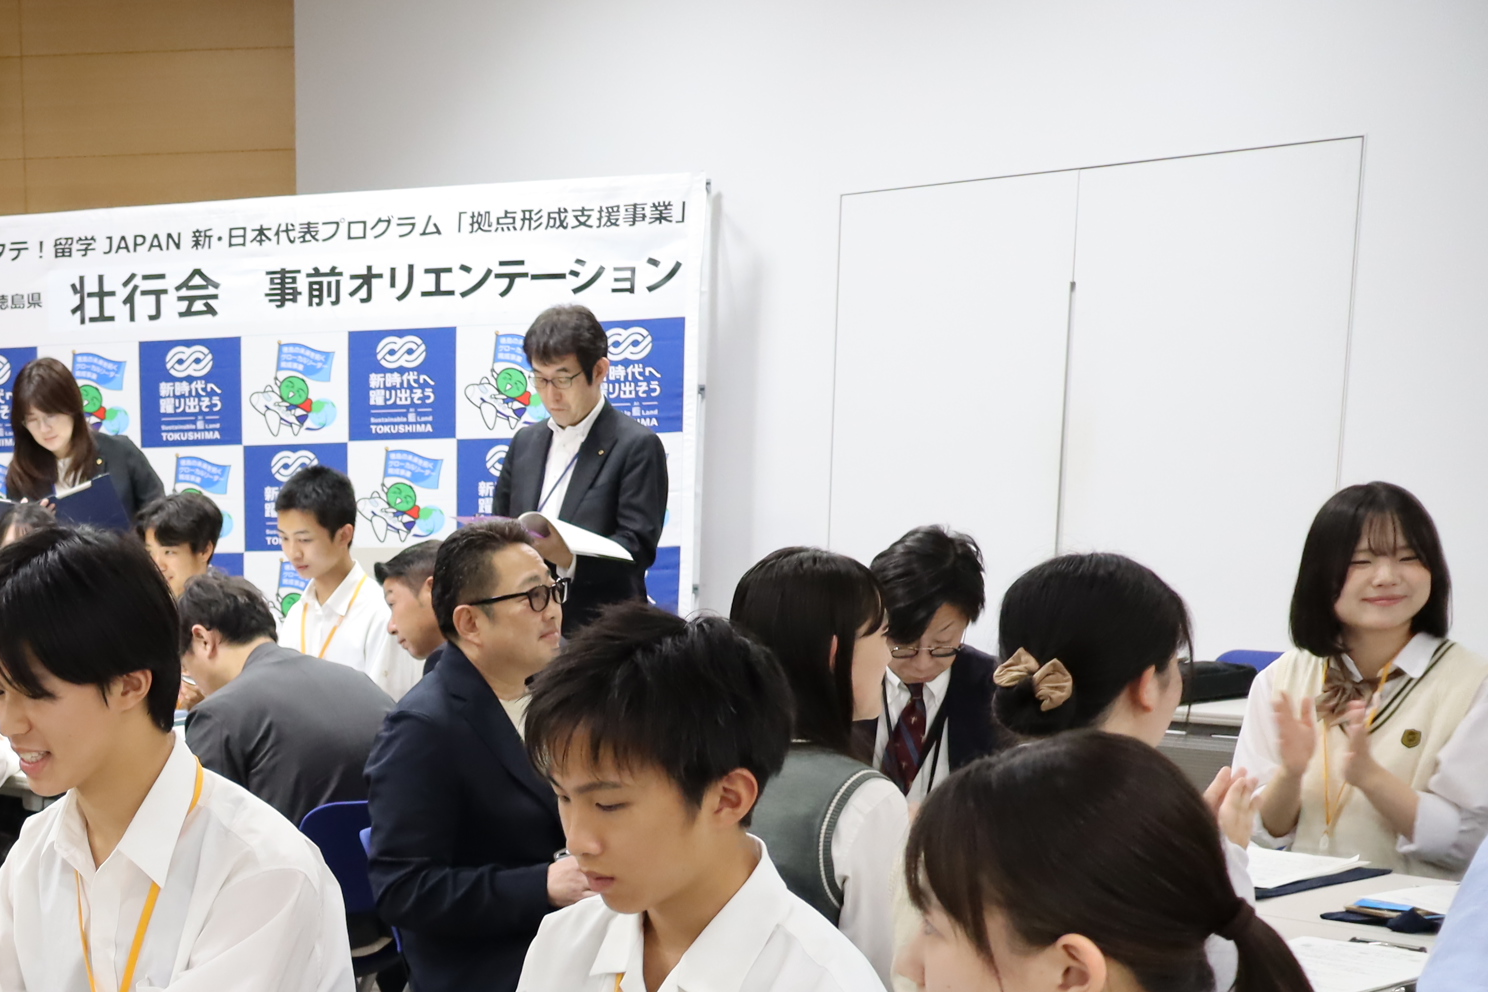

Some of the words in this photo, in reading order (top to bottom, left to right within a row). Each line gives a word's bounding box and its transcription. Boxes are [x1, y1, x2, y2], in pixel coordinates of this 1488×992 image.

[103, 232, 182, 255] JAPAN
[70, 268, 221, 325] 壮行会
[264, 257, 682, 309] 事前オリエンテーション
[161, 431, 221, 441] TOKUSHIMA
[370, 423, 433, 434] TOKUSHIMA
